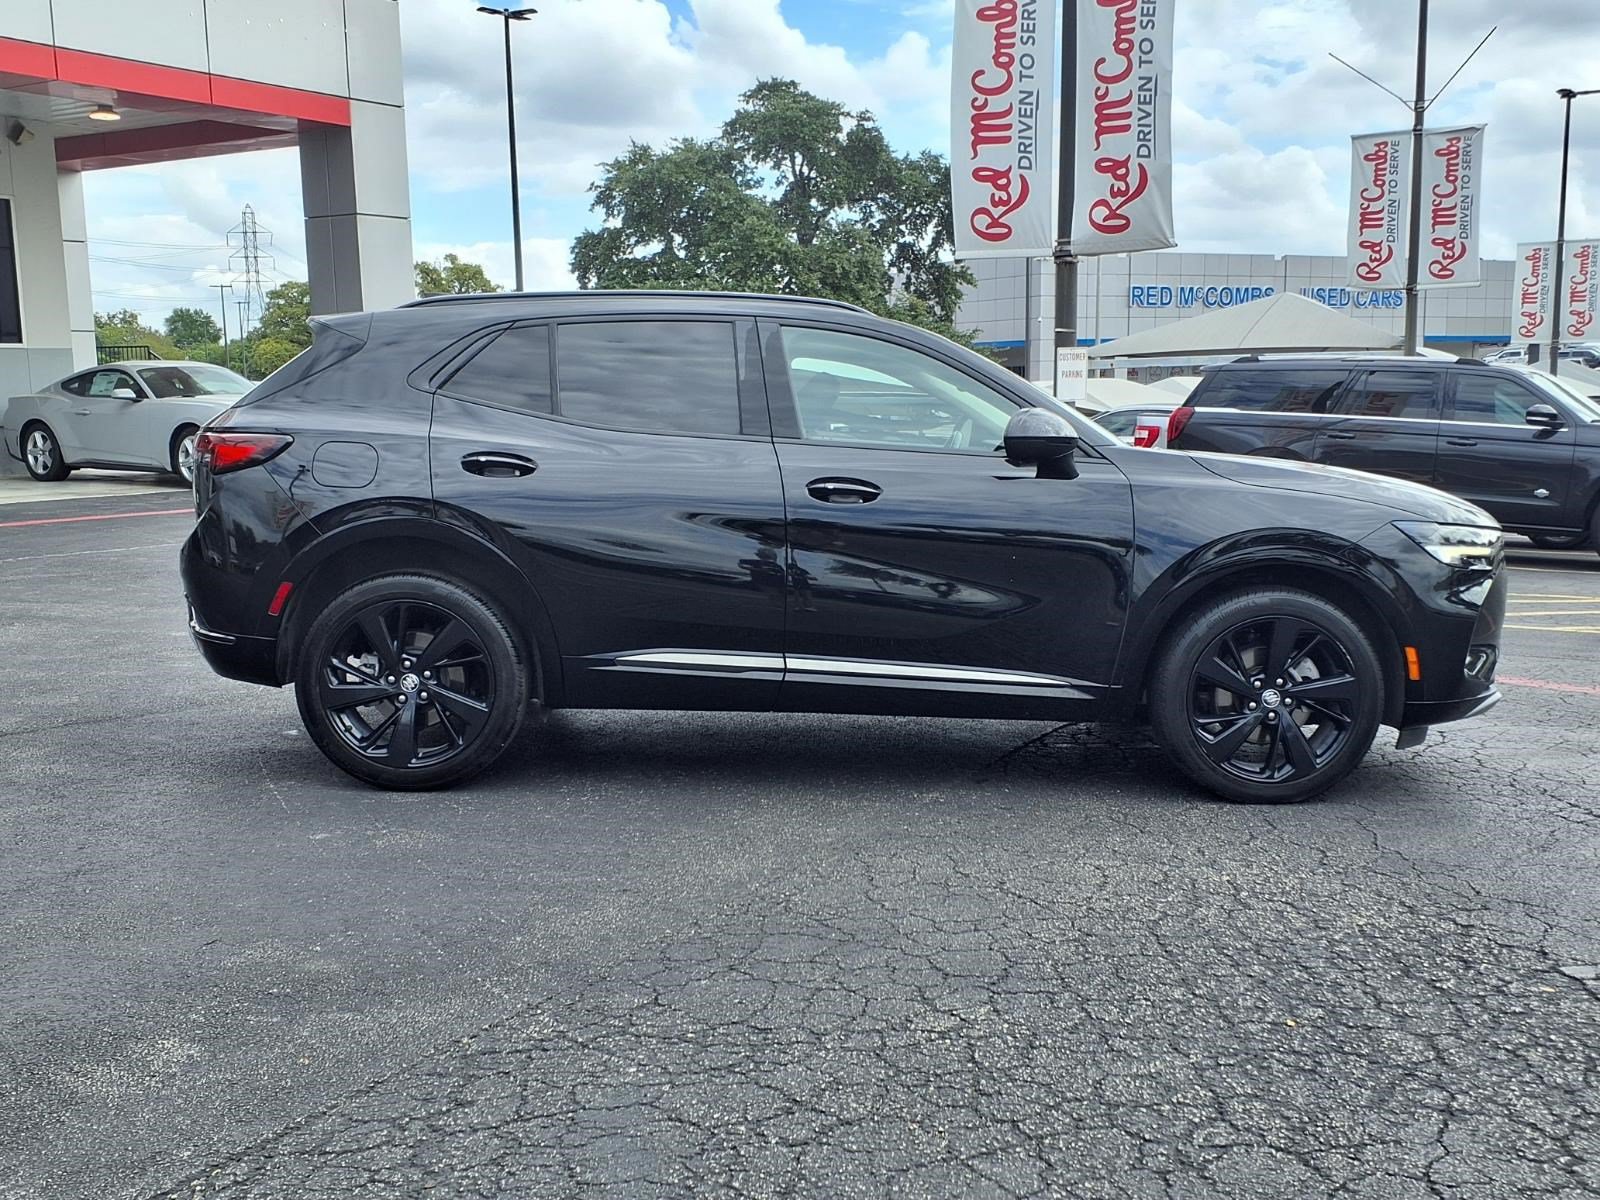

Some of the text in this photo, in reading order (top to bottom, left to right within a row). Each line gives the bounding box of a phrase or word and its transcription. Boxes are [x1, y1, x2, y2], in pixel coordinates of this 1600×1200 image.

[1019, 53, 1035, 82] TO
[1138, 37, 1154, 69] TO
[1018, 89, 1034, 171] DRIVEN
[1137, 75, 1153, 159] DRIVEN
[970, 165, 1030, 242] Red
[1089, 154, 1148, 234] Red
[1356, 141, 1393, 282] Red McCombs
[1386, 140, 1400, 243] DRIVEN TO SERVE
[1428, 136, 1467, 279] Red McCombs
[1459, 136, 1472, 240] DRIVEN TO SERVE
[1131, 286, 1173, 306] RED
[1356, 290, 1403, 307] CARS
[1518, 247, 1544, 338] Red McCombs
[1539, 247, 1550, 314] DRIVEN TO SERVE
[1567, 244, 1593, 336] Red McCombs
[1588, 244, 1599, 312] DRIVEN TO SERVE
[1060, 352, 1086, 361] CUSTOMER
[1062, 370, 1083, 378] PARKING
